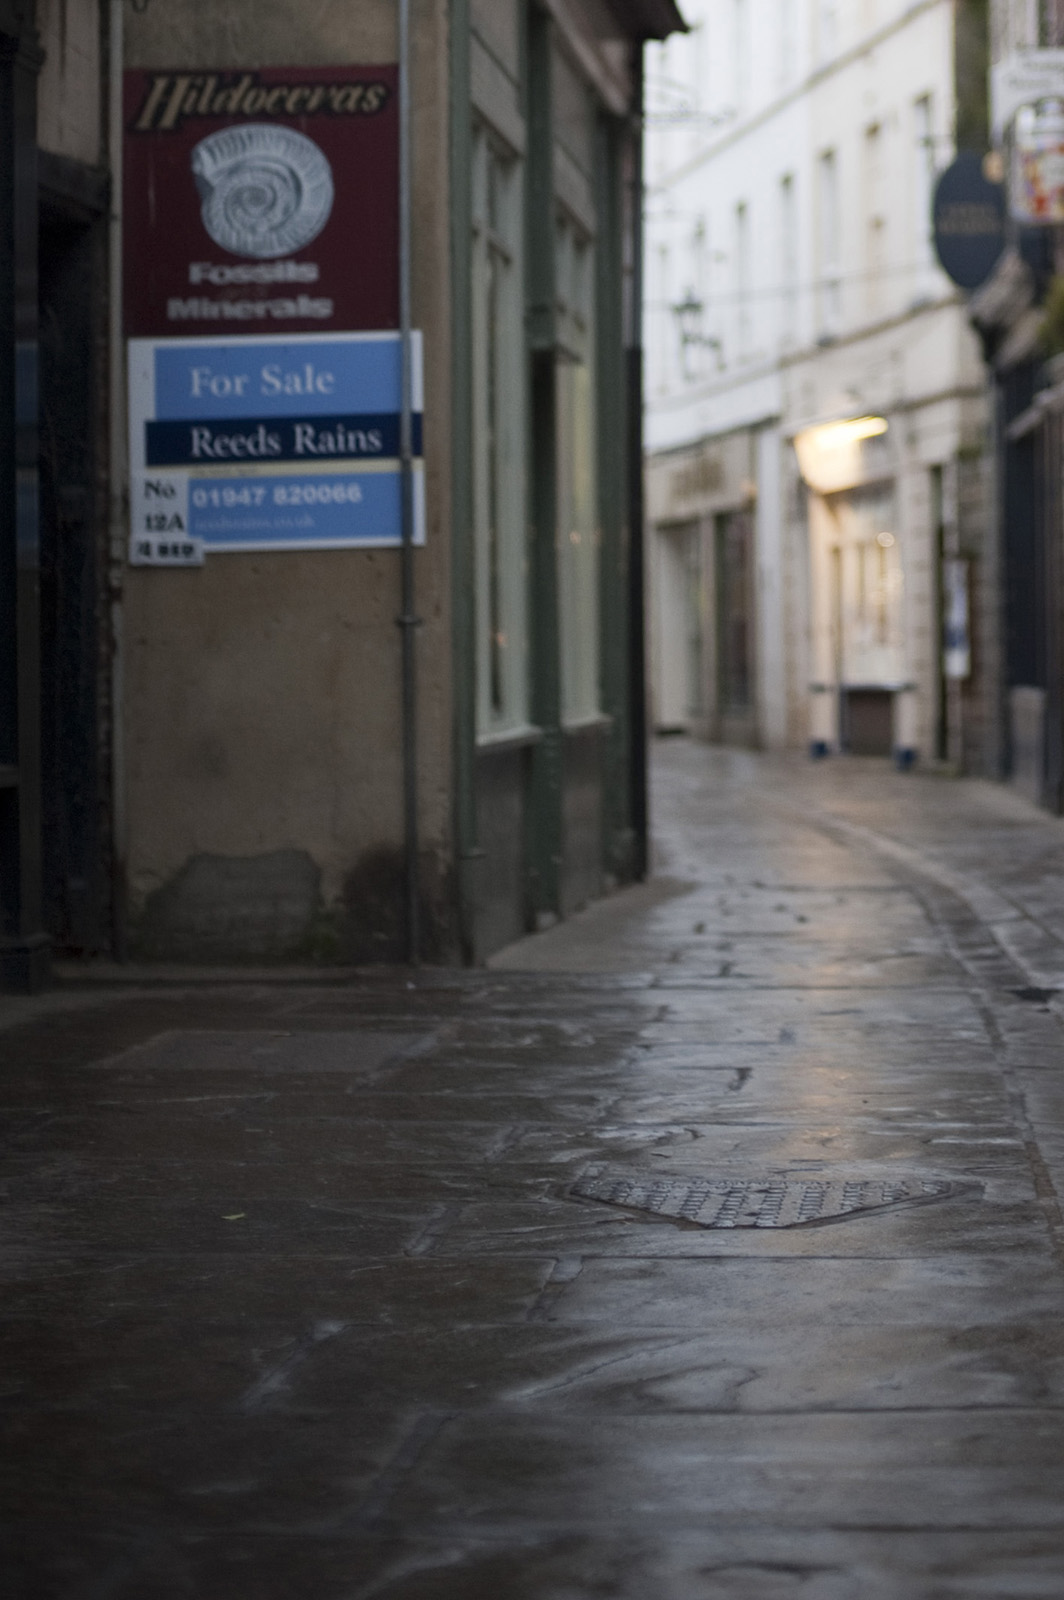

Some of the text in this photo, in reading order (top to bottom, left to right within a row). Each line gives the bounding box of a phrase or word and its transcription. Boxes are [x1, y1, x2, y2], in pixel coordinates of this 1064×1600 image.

[134, 73, 388, 131] Hildoceras
[188, 260, 320, 285] Fossils
[167, 294, 335, 321] Minerals
[189, 363, 335, 398] For Sale
[189, 421, 384, 458] Reeds Rains
[192, 485, 267, 509] 01947
